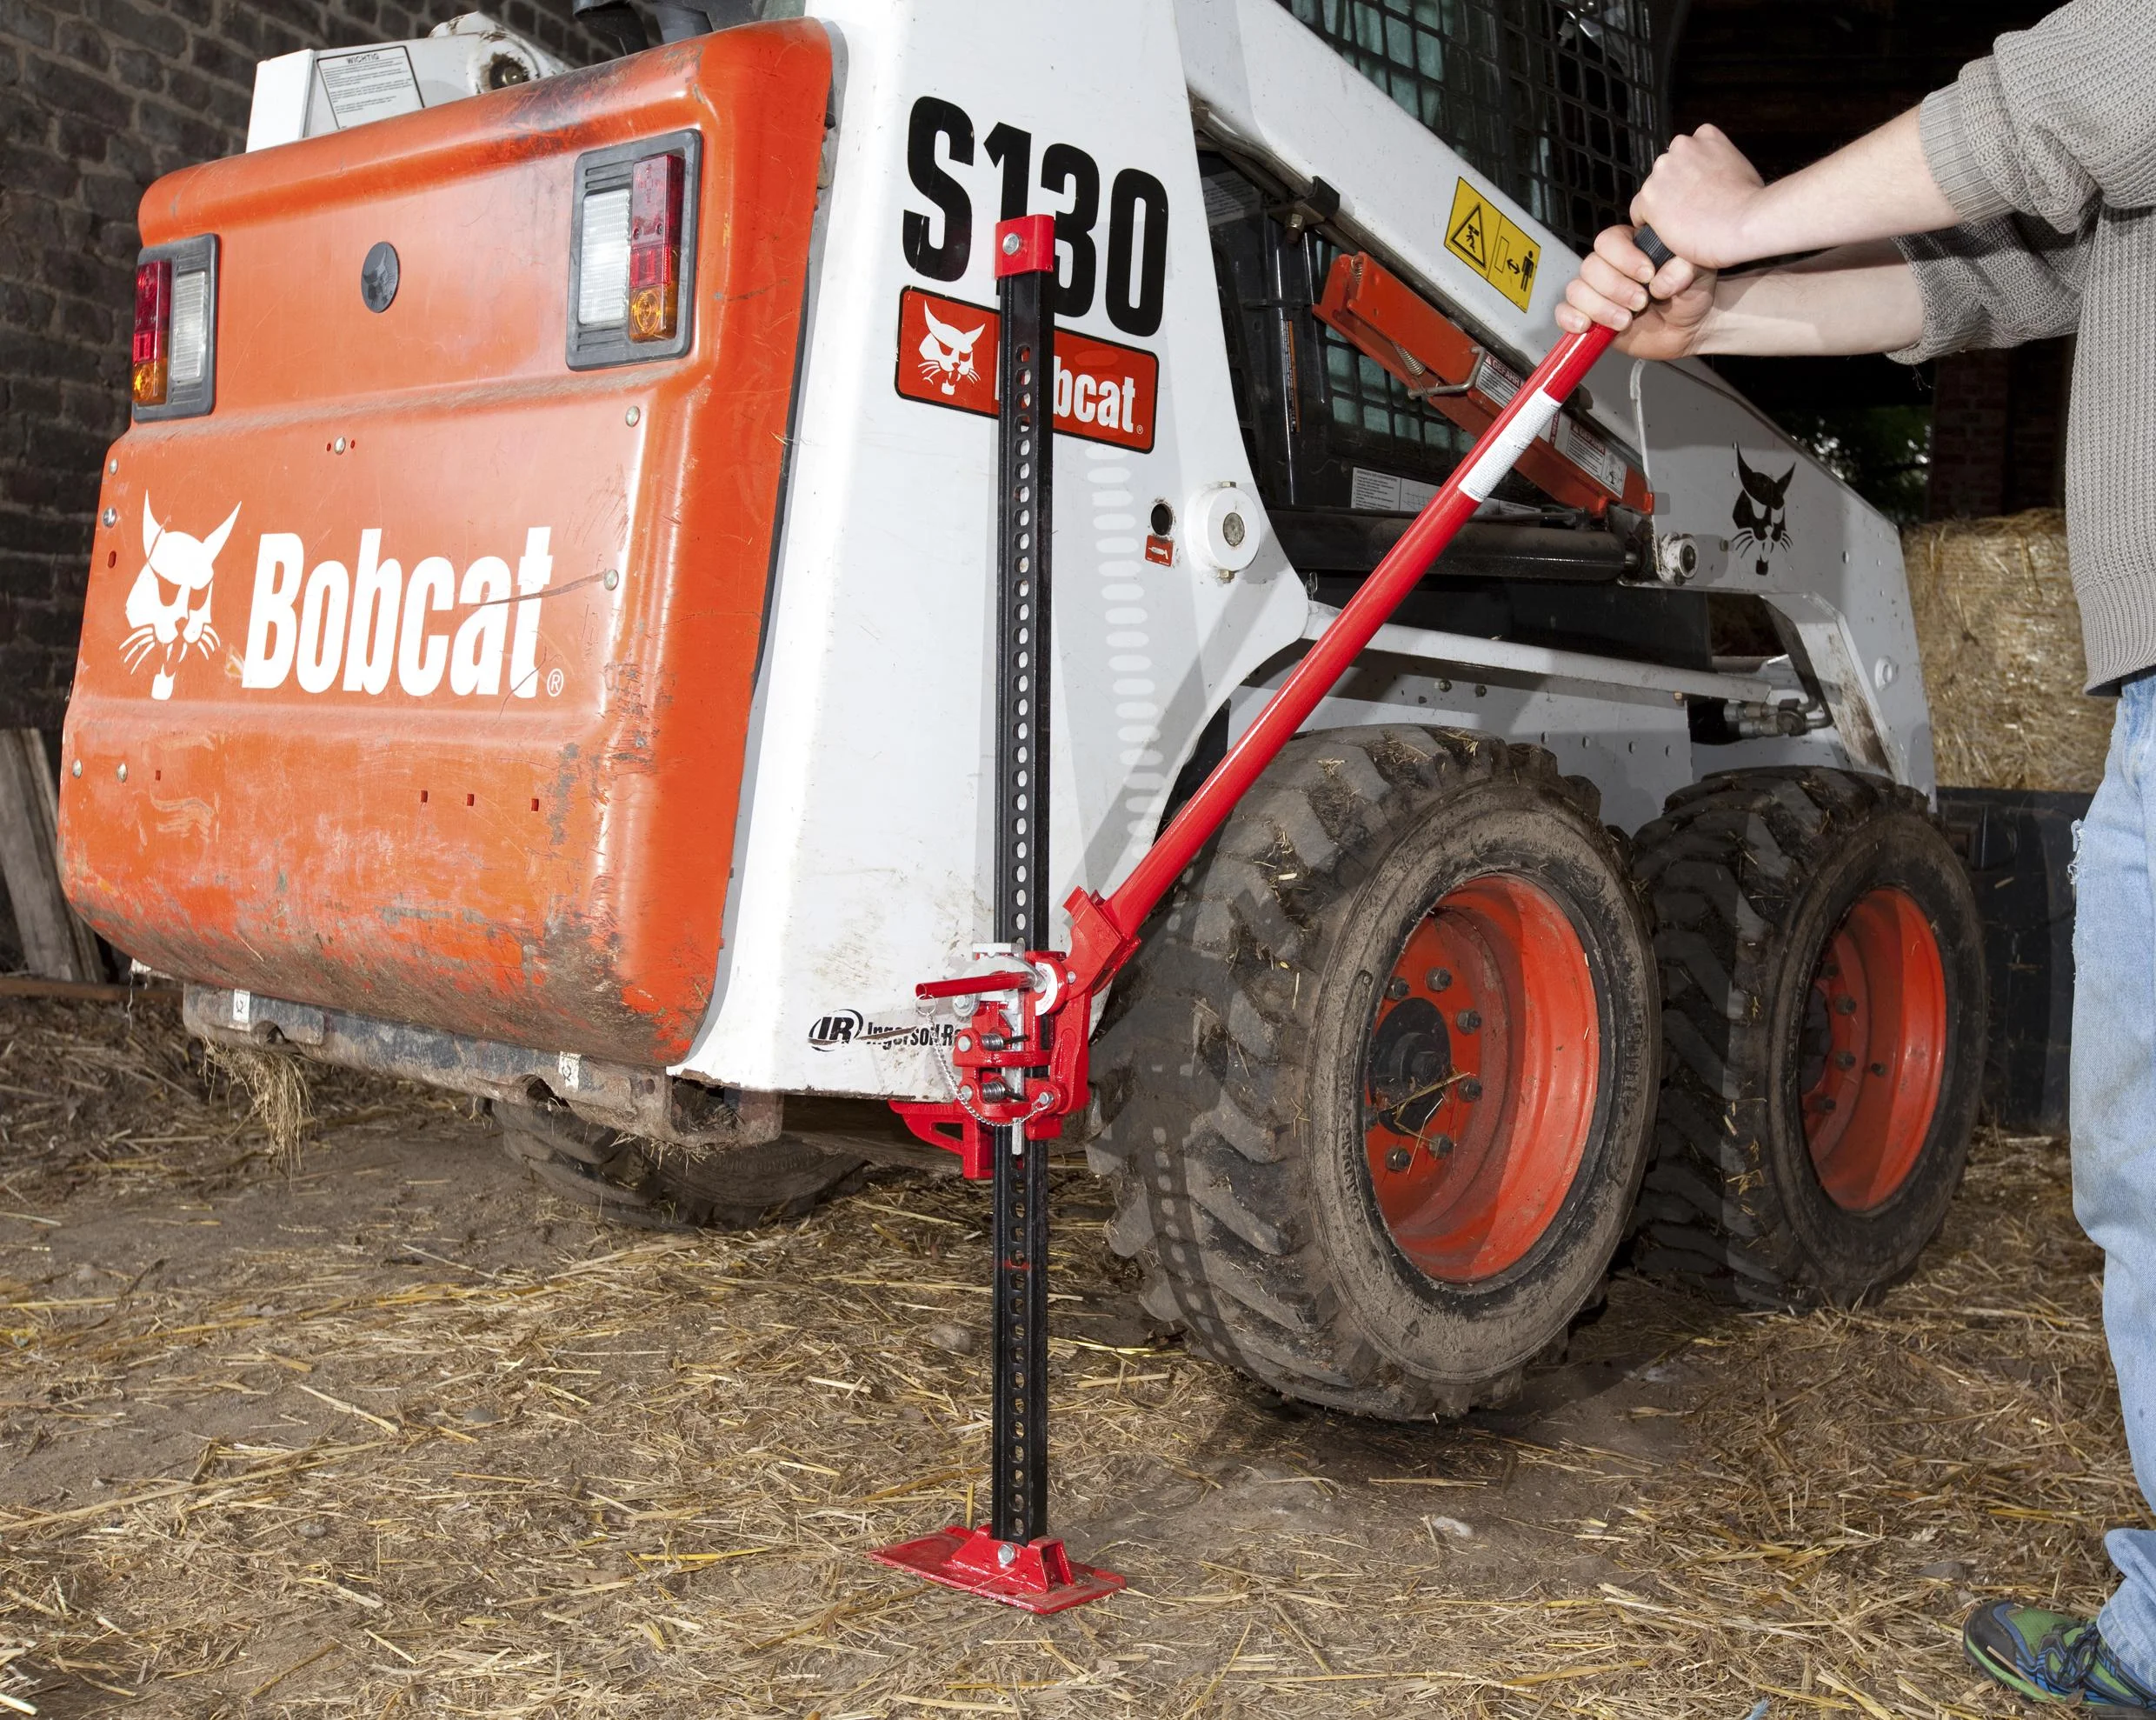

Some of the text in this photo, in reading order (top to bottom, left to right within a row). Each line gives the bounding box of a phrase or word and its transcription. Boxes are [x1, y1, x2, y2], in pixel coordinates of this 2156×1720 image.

[346, 53, 380, 64] WICHTIG
[902, 96, 1169, 337] S130
[1493, 359, 1520, 387] GEFAHR
[242, 526, 553, 699] Bobcat
